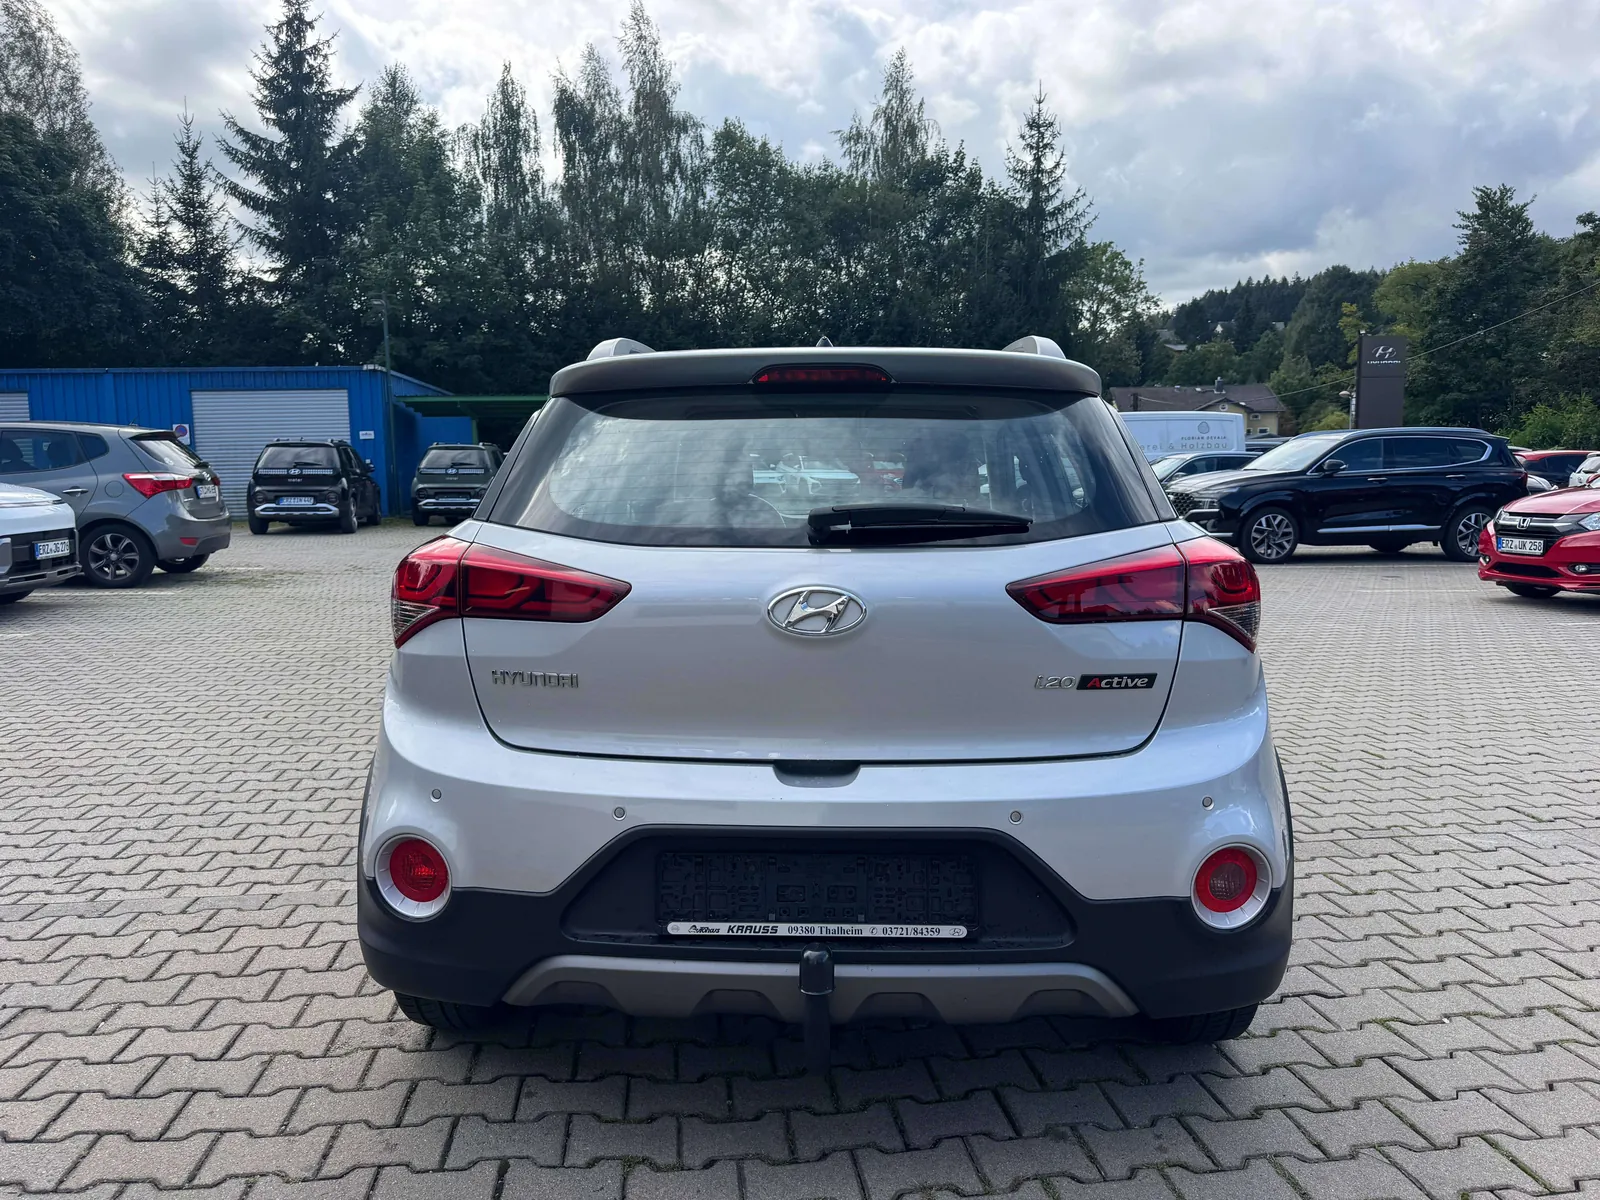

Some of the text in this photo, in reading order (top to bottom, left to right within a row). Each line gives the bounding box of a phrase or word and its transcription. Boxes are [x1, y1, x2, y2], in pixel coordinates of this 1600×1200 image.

[1181, 442, 1228, 450] Holzbau
[39, 544, 49, 555] ERZ
[1502, 539, 1543, 551] ERZ UK 258
[492, 669, 579, 688] HYUNDAI
[1034, 674, 1149, 689] i20 Active
[726, 925, 779, 934] KRAUSS
[787, 925, 815, 935] 09380
[818, 925, 863, 936] Thalheim
[882, 927, 941, 937] 03721/84359
